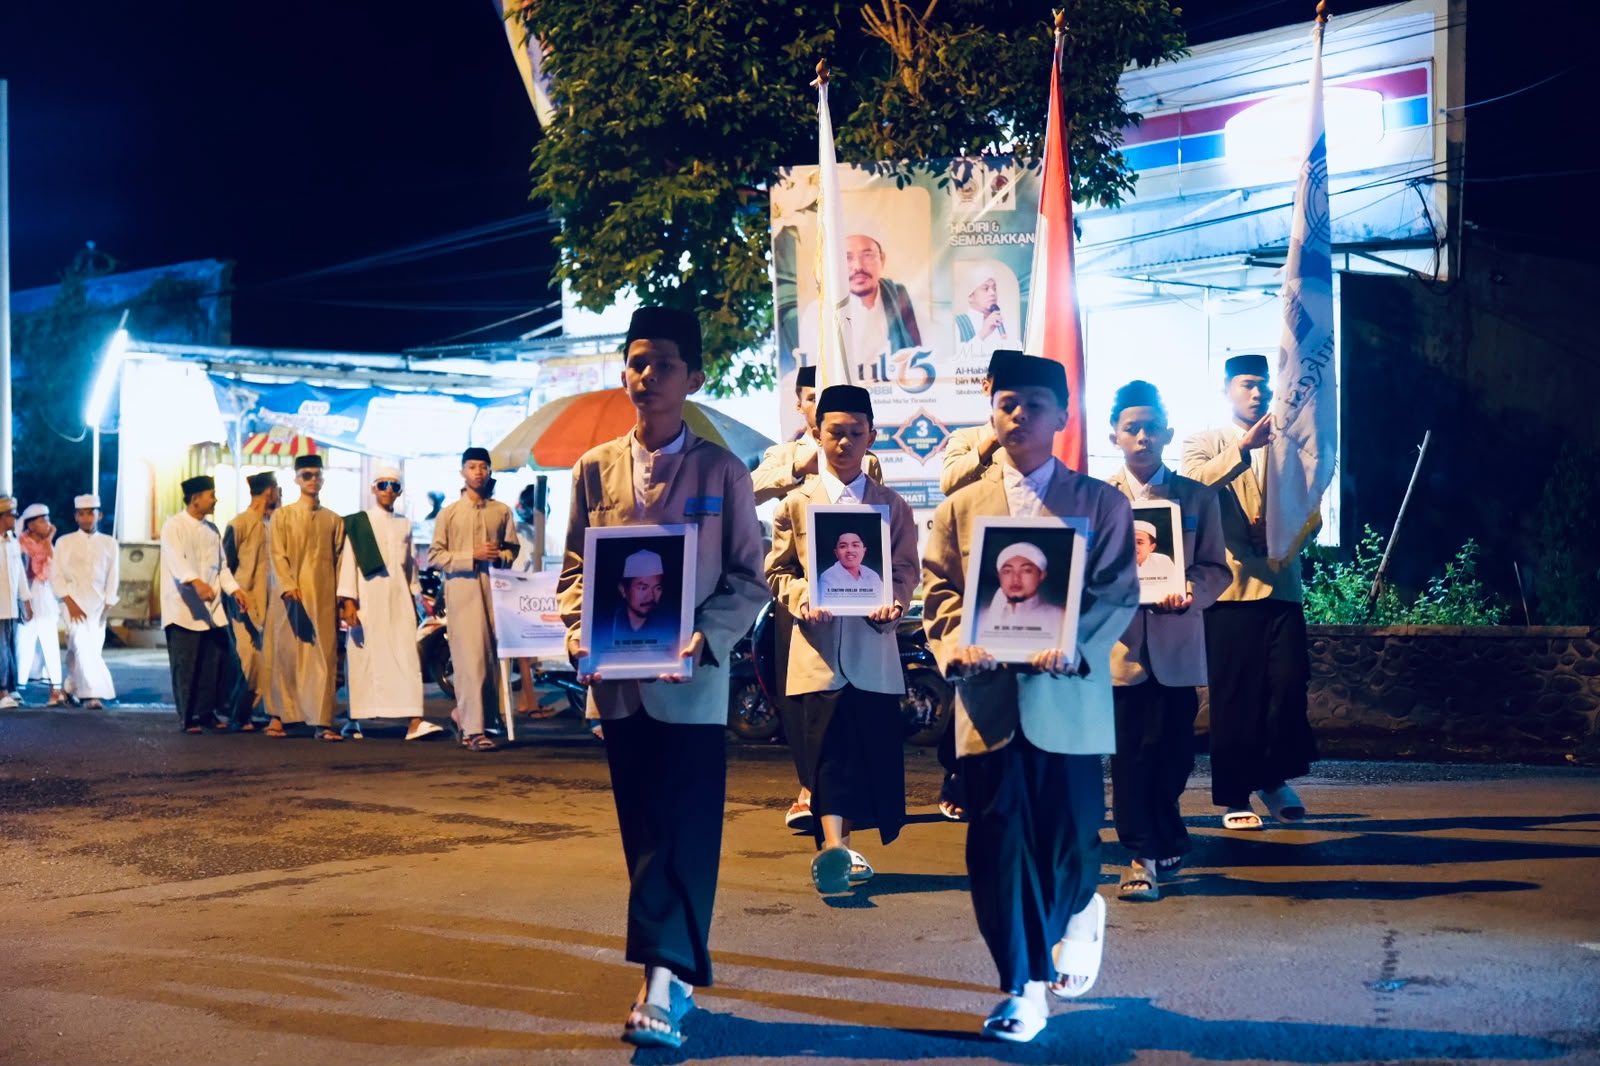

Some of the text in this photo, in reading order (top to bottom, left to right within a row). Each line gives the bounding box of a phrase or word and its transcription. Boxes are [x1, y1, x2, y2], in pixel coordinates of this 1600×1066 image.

[950, 220, 1000, 233] HADIRI &
[951, 232, 1036, 246] SEMARAKKAN
[916, 420, 929, 437] 3
[901, 494, 926, 502] HATI
